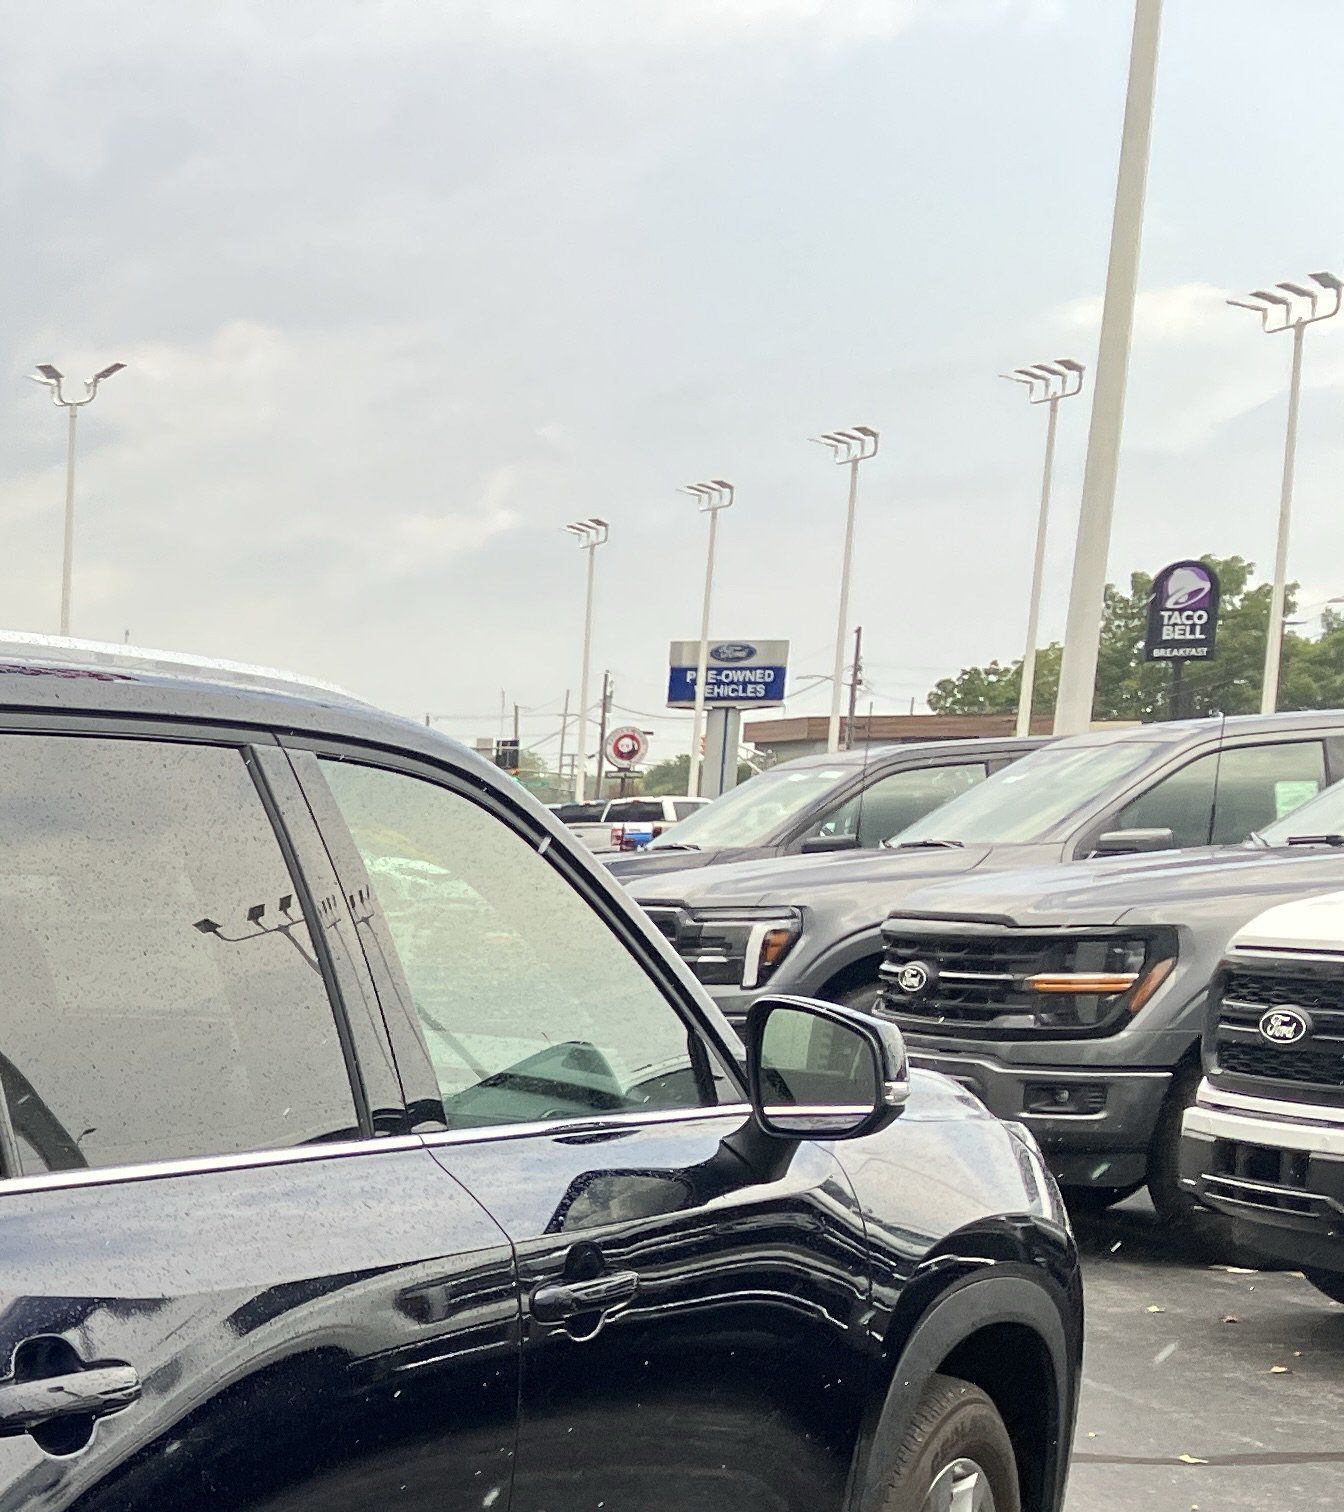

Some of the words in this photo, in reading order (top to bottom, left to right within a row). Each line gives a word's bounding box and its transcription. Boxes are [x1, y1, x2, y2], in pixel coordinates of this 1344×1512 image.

[1160, 610, 1208, 625] TACO
[1161, 625, 1207, 640] BELL
[1153, 647, 1208, 657] BREAKFAST
[686, 669, 775, 683] PE-OWNED
[694, 684, 766, 697] EHICLES
[1264, 1013, 1299, 1040] Ford
